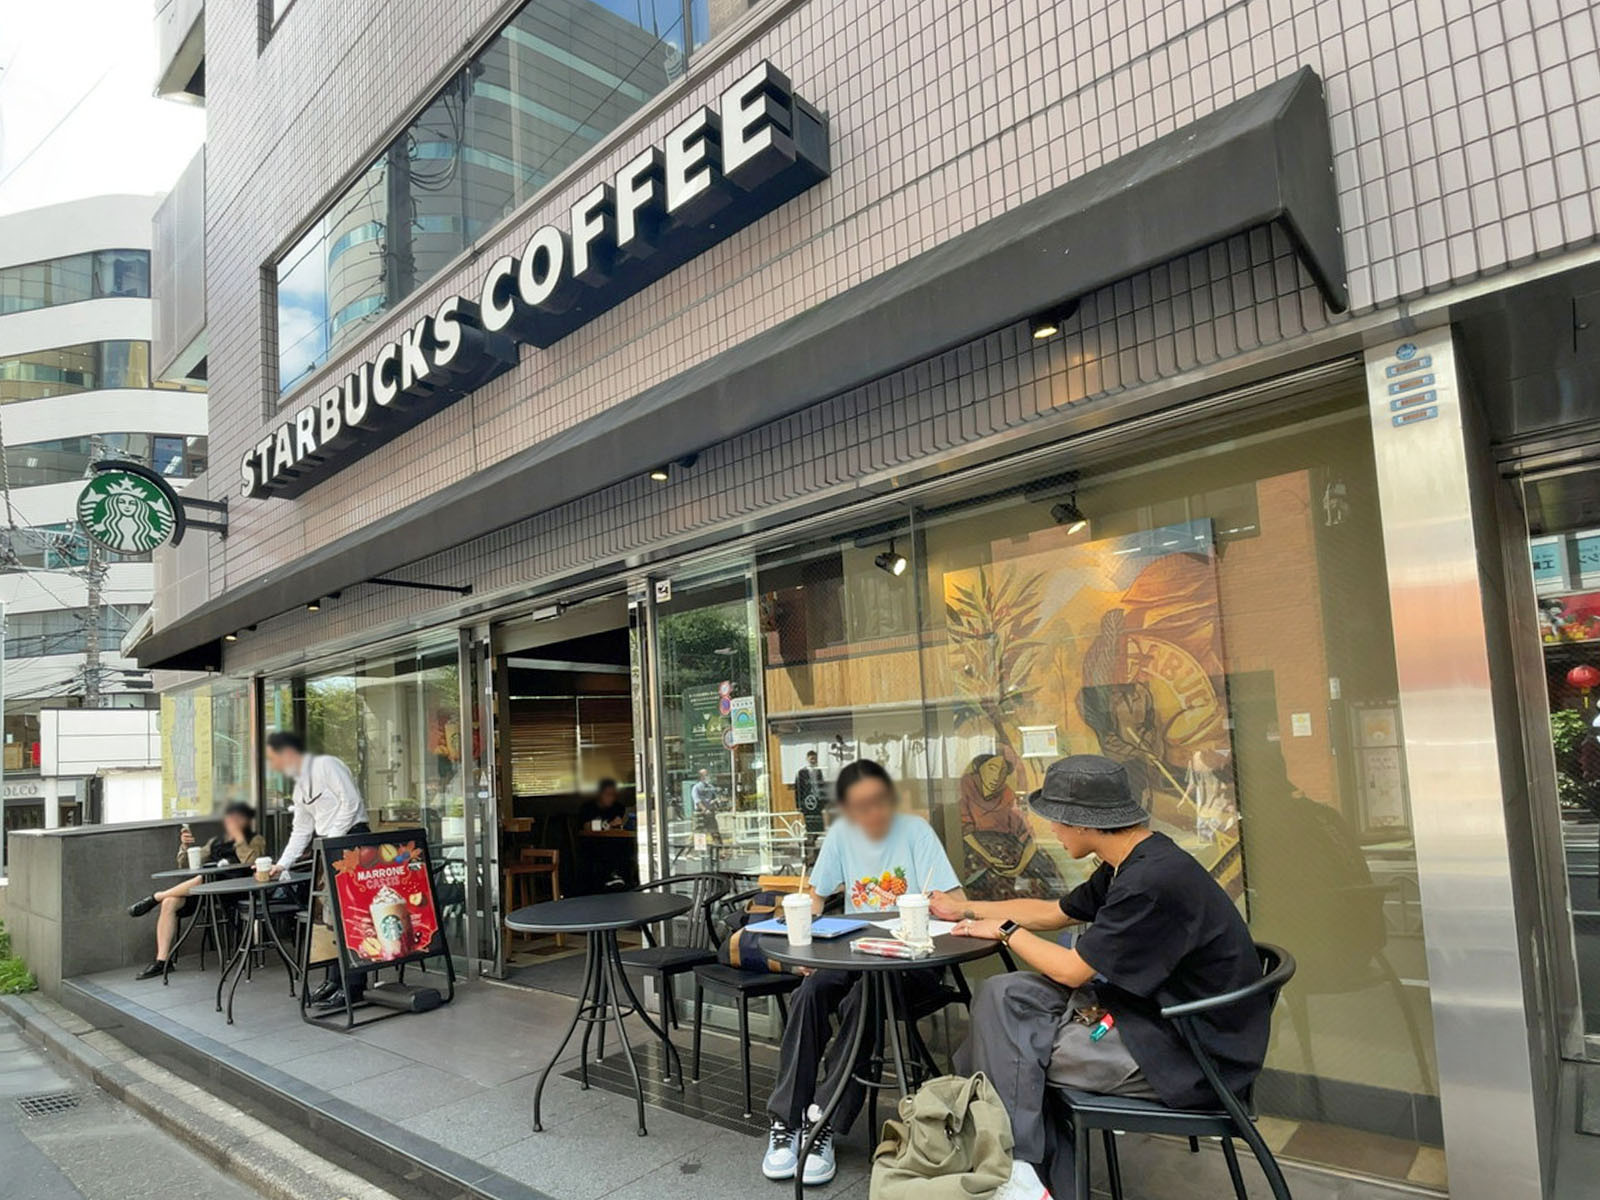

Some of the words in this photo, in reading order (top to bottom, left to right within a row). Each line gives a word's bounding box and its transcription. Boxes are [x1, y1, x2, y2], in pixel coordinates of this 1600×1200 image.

[240, 296, 462, 497] STARBUCKS
[480, 59, 773, 331] COFFEE
[357, 865, 405, 881] MARRONE
